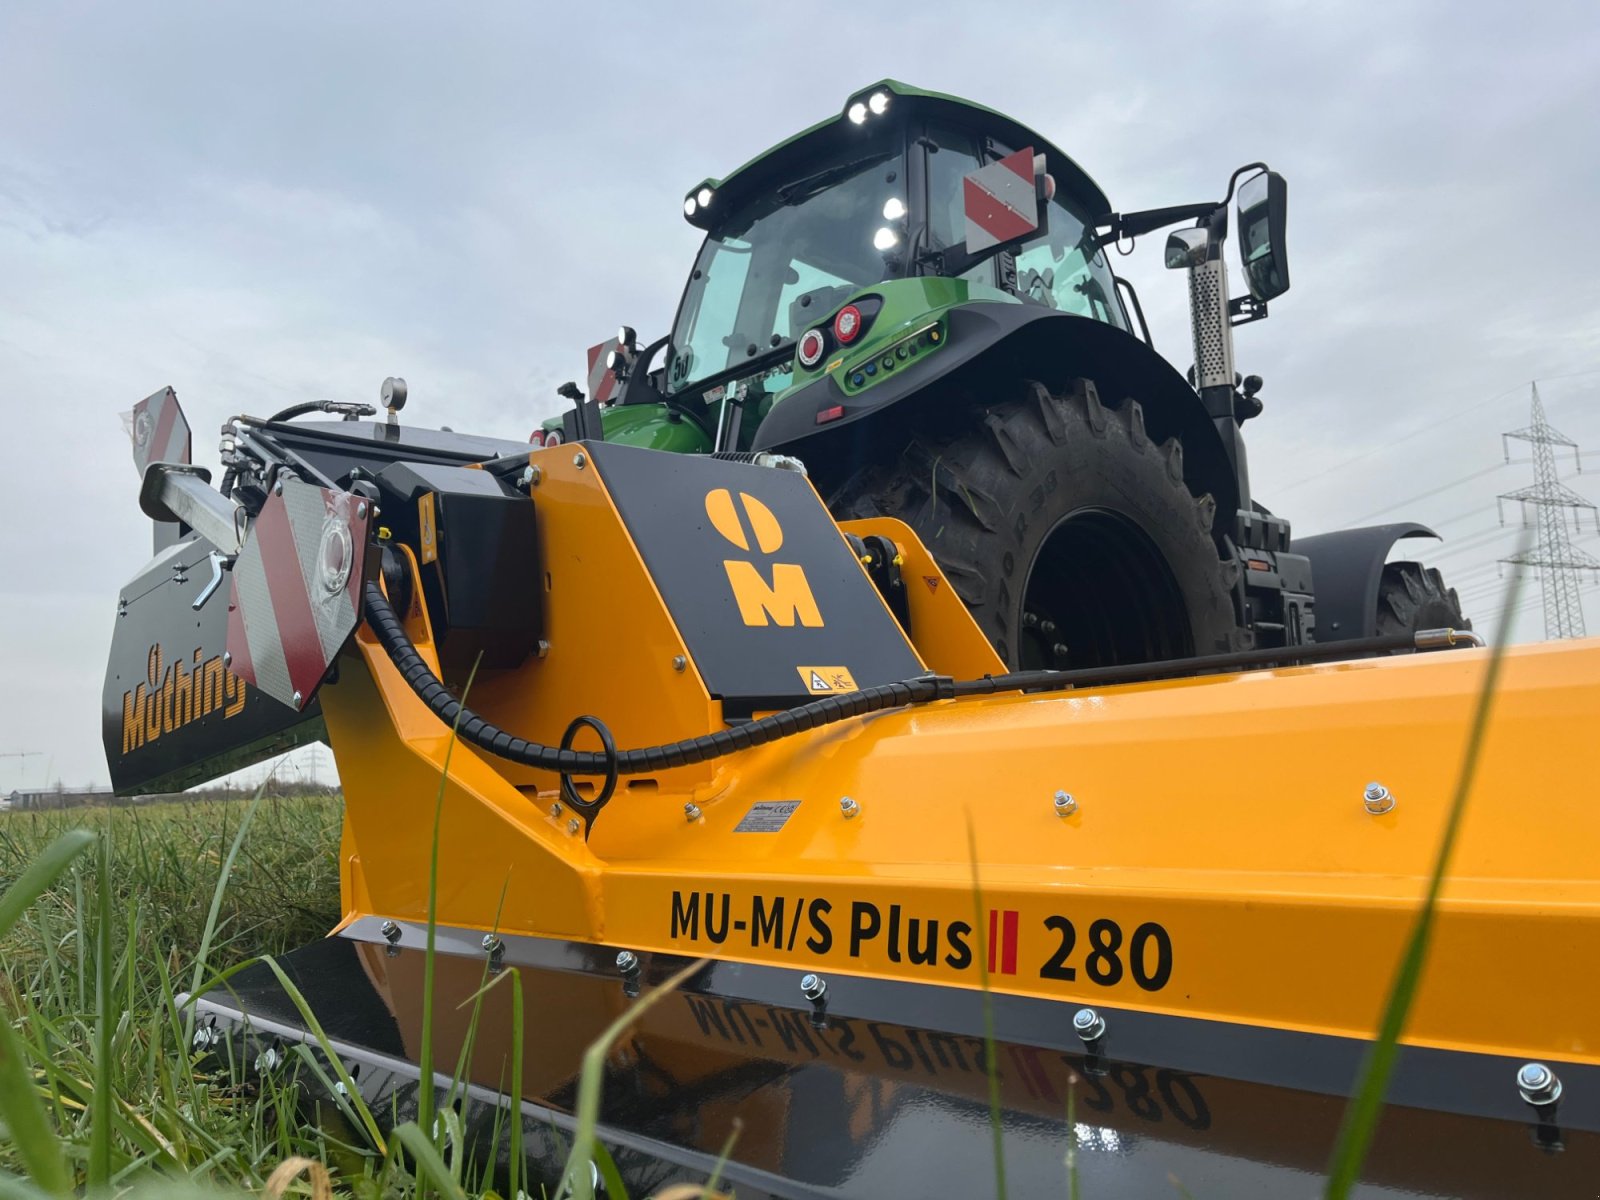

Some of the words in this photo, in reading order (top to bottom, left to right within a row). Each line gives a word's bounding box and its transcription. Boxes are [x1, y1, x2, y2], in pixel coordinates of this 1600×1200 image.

[122, 642, 247, 755] Müthing
[670, 891, 833, 955] MU-M/S
[849, 901, 973, 970] Plus
[1039, 915, 1173, 992] 280
